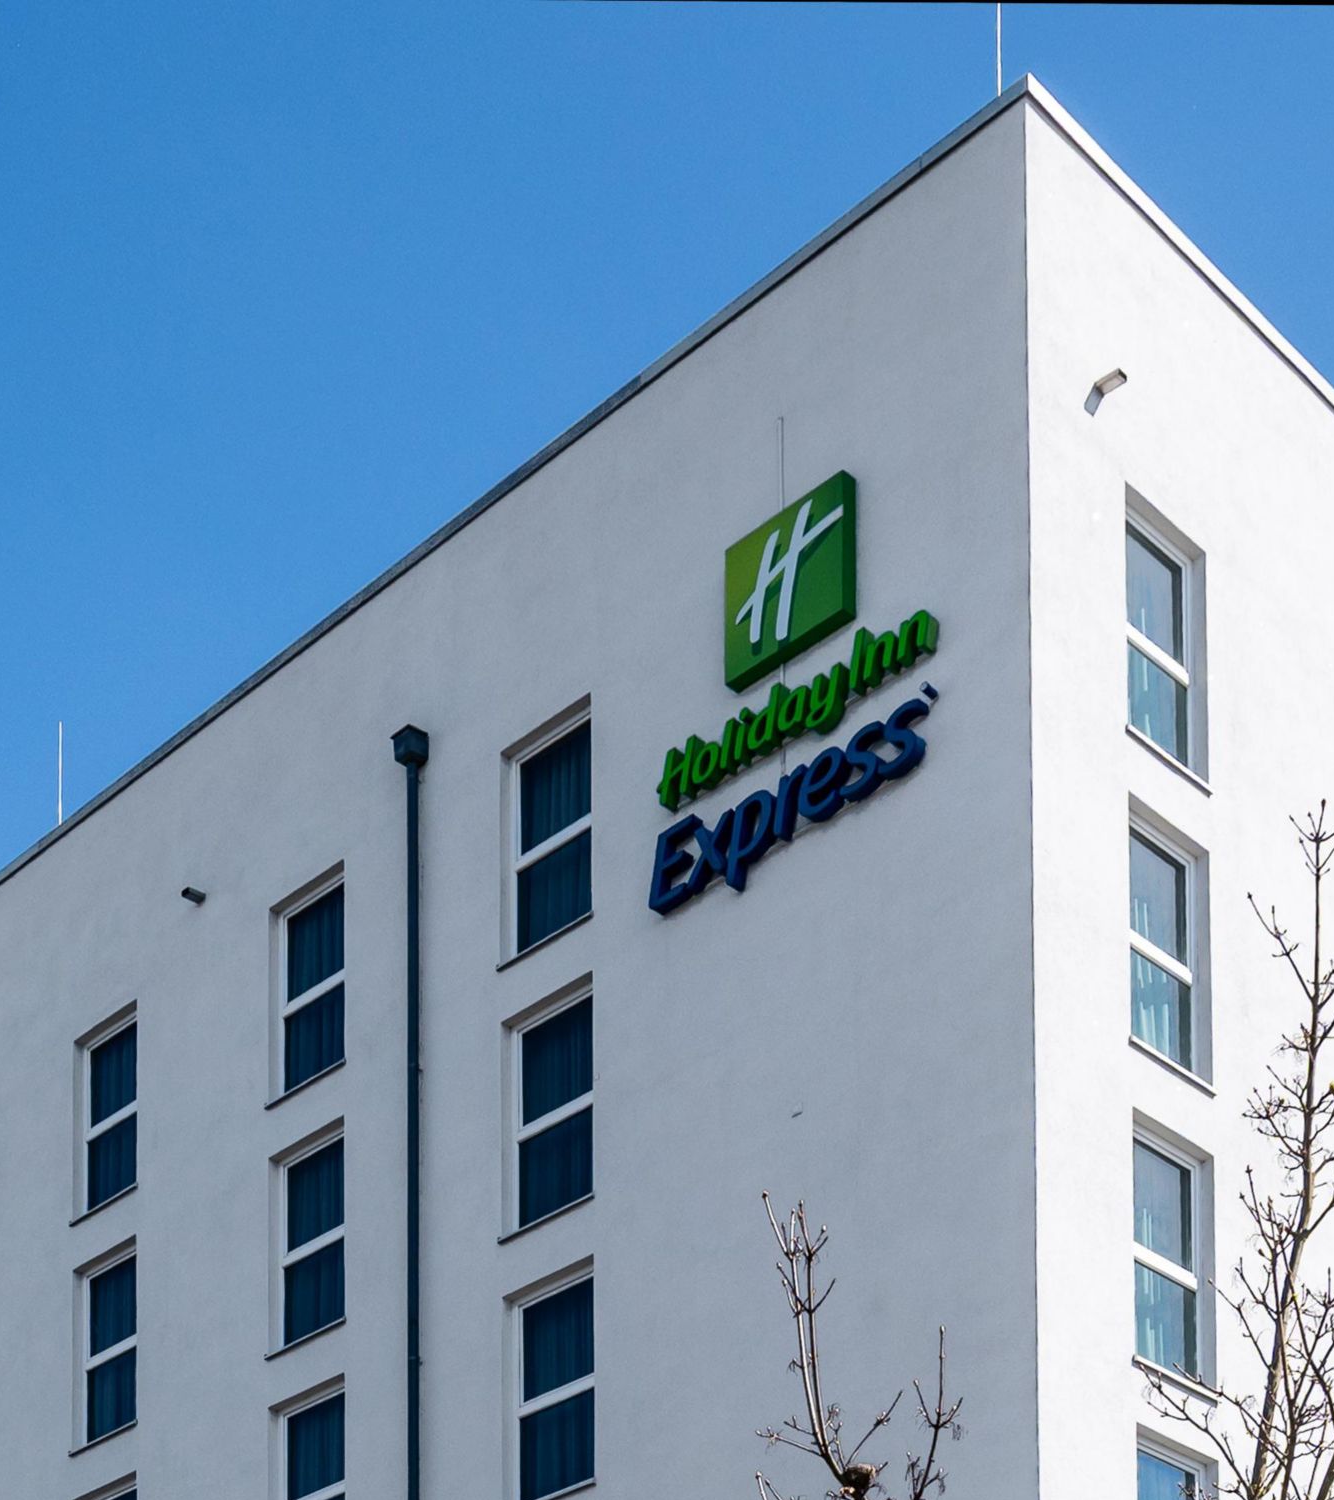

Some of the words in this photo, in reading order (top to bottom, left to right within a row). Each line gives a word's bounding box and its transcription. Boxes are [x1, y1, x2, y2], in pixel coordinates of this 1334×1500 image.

[649, 695, 931, 915] Express
[656, 661, 851, 812] Holiday
[849, 609, 939, 697] Inn
